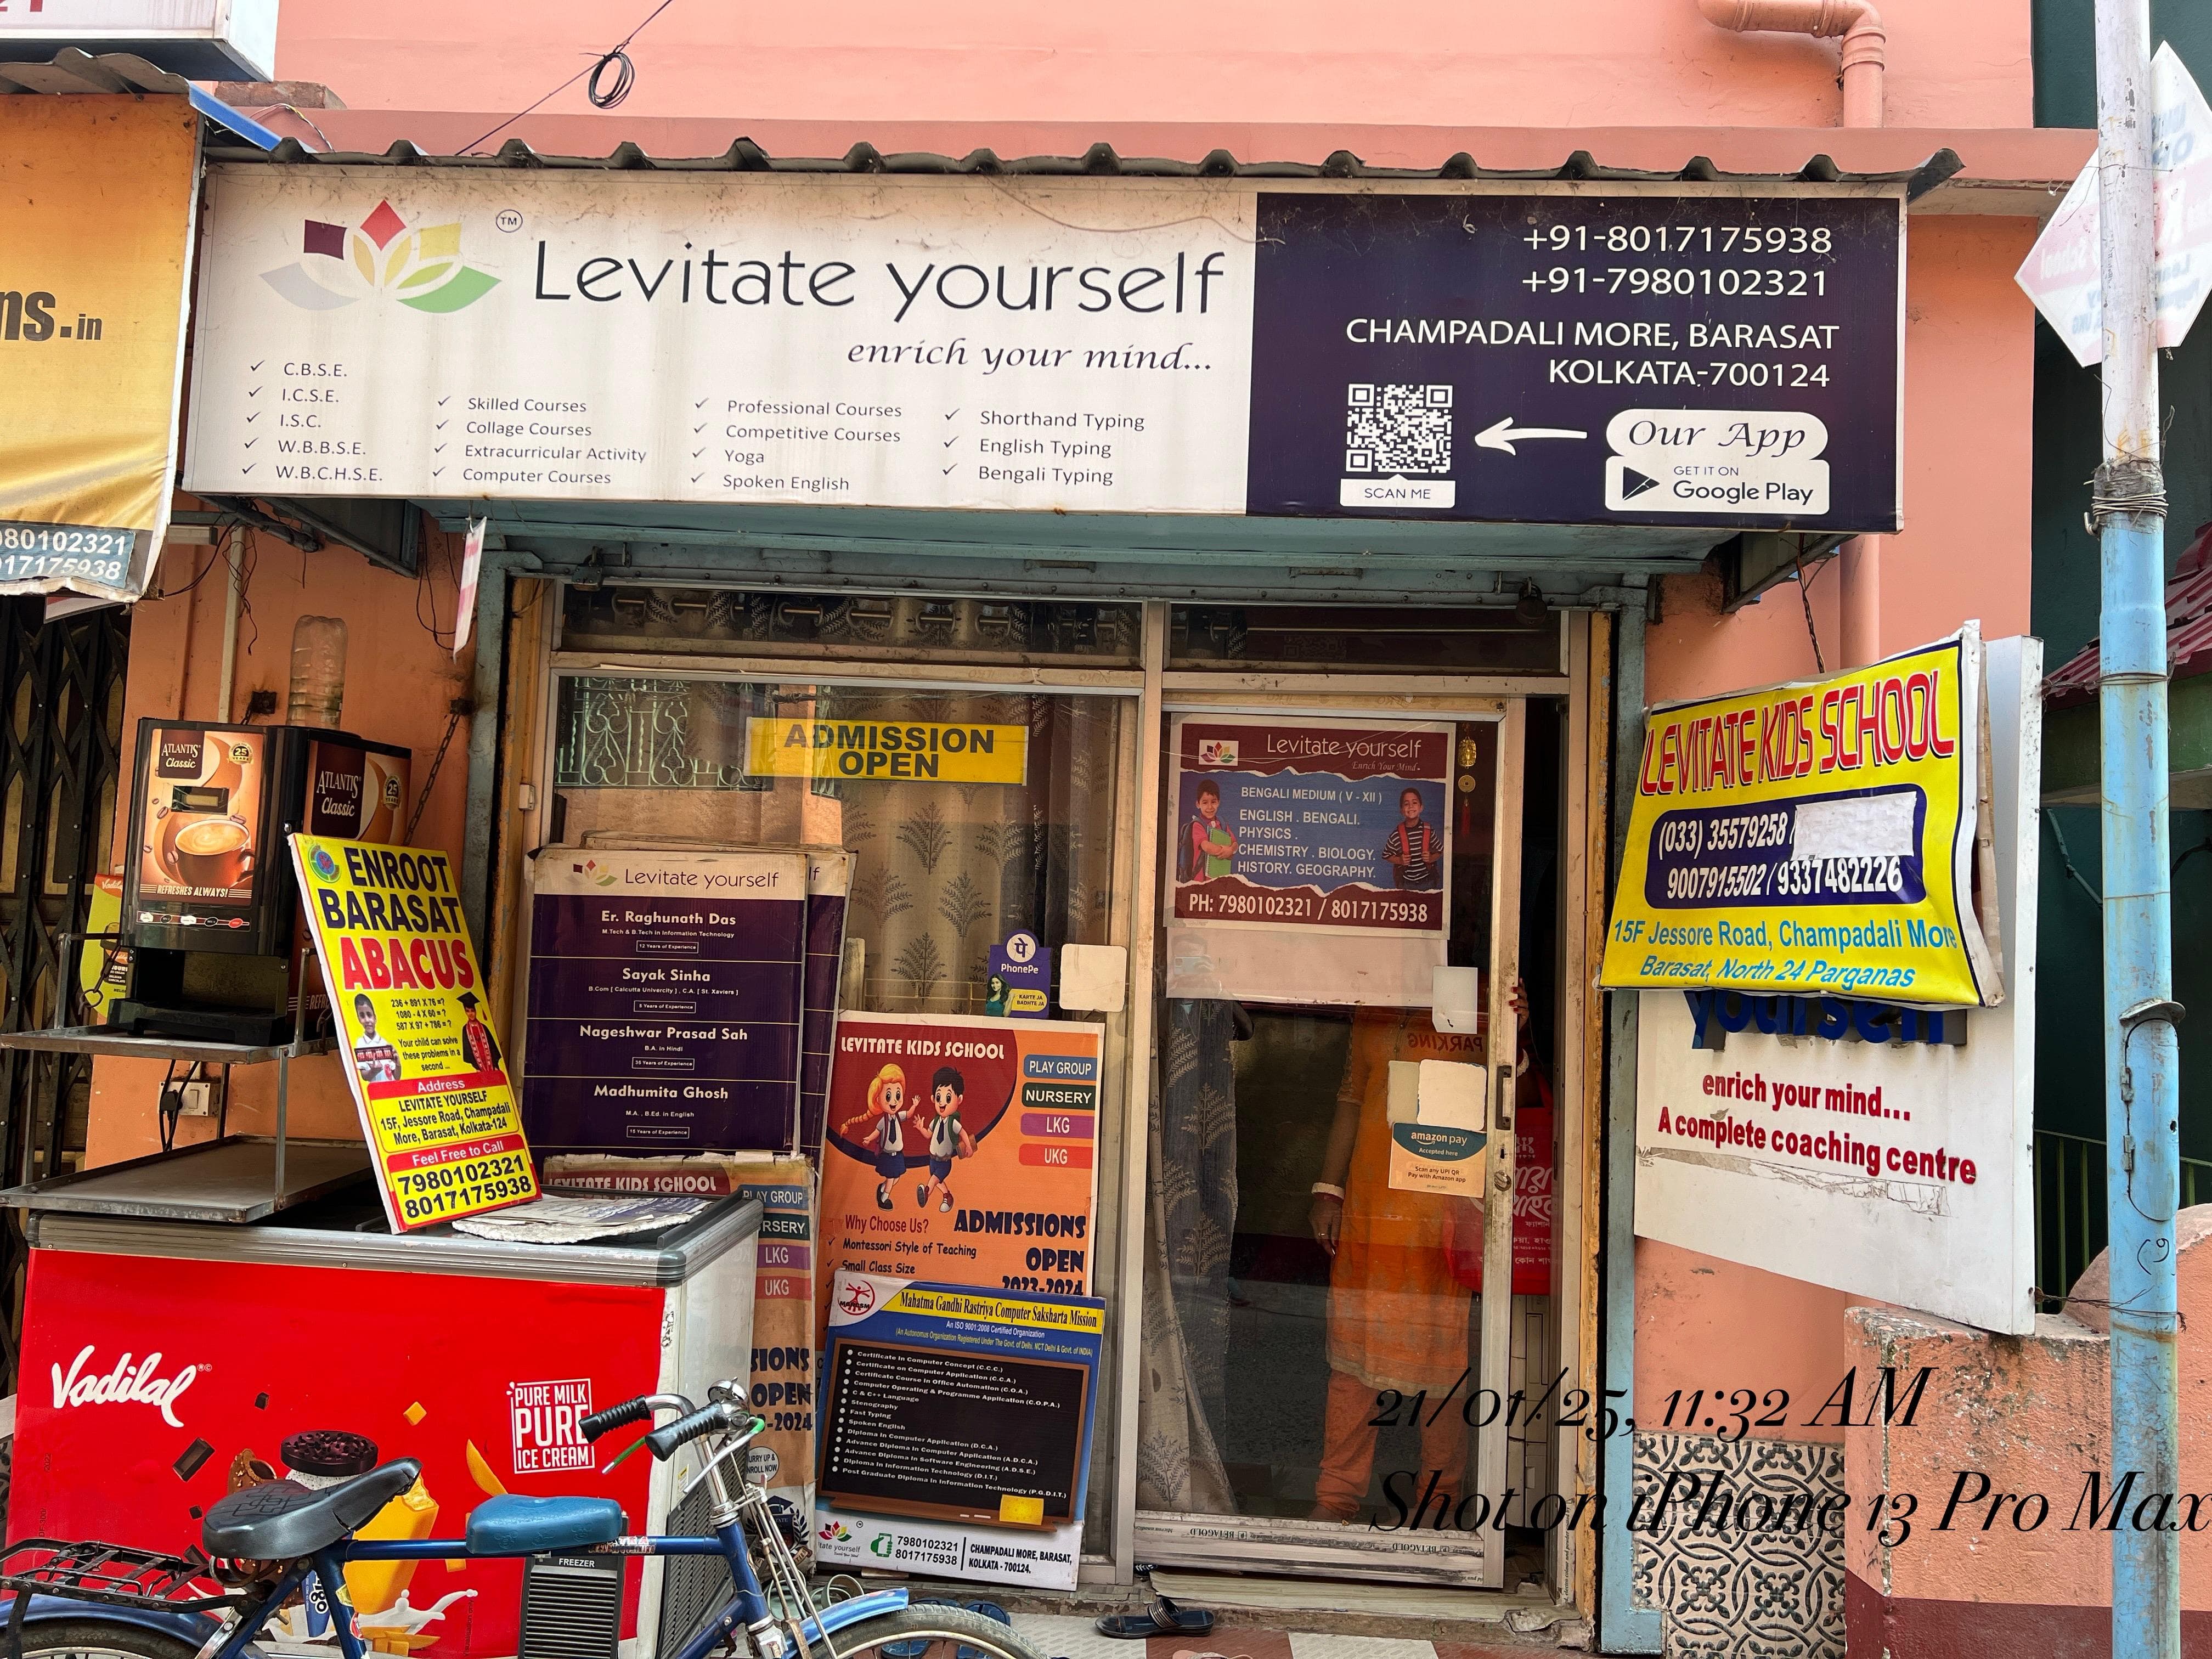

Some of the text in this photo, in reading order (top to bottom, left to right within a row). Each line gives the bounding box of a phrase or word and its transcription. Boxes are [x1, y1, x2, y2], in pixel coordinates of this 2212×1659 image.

[1524, 225, 1831, 253] +91-8017175938
[536, 241, 1224, 323] Levitate yourself
[1523, 267, 1824, 295] +91-7980102321
[1347, 319, 1839, 350] CHAMPADALI MORE, BARASAT
[848, 338, 1210, 374] enrich your mind...
[284, 363, 347, 376] C.B.S.E.
[283, 389, 338, 402] I.C.S.E.
[469, 398, 586, 411] Skilled Courses
[729, 400, 901, 416] Professional Courses
[281, 414, 320, 427] I.S.C.
[467, 422, 591, 437] Collage Courses
[981, 411, 1144, 431] Shorthand Typing
[727, 425, 900, 442] Competitive Courses
[1629, 421, 1805, 457] Our App
[279, 440, 365, 454] W.B.B.S.E.
[466, 445, 646, 463] Extracurricular Activity
[981, 439, 1111, 458] English Typing
[725, 450, 764, 465] Yoga
[276, 466, 382, 481] W.B.C.H.S.E.
[464, 469, 610, 483] Computer Courses
[980, 466, 1113, 486] Bengali Typing
[724, 475, 848, 492] Spoken English
[1674, 481, 1813, 505] Google Play
[1365, 488, 1431, 499] SCAN ME
[0, 529, 126, 557] 80102321
[784, 725, 994, 753] ADMISSION
[1640, 671, 1954, 796] LEVITATE KIDS SCHOOL
[161, 744, 198, 758] ATLANTIS
[1268, 735, 1421, 758] Levitate yourself
[166, 758, 196, 768] Classic
[839, 751, 938, 777] OPEN
[317, 771, 358, 798] ATLANTIS
[1242, 787, 1335, 800] BENGALI MEDIUM
[321, 797, 354, 816] Classic
[1240, 809, 1359, 825] ENGLISH BENGALI.
[1239, 827, 1291, 839] PHYSICS
[1659, 812, 1788, 860] (033) 35579258
[1239, 844, 1375, 860] CHEMISTRY BIOLOGY.
[343, 847, 448, 892] ENROOT
[626, 869, 778, 889] Levitate yourself
[1238, 861, 1375, 878] HISTORY. GEOGRAPHY.
[1668, 857, 1903, 899] 9007915502 9337482226
[157, 885, 228, 897] REFRESHES ALWAYS!
[318, 889, 461, 933] BARASAT
[1189, 894, 1427, 922] PH: 7980102321 8017175938
[602, 911, 736, 925] Er. Raghunath Das
[1615, 919, 1957, 953] 15F Jessore Road, Champadali More
[341, 937, 474, 990] ABACUS
[1001, 964, 1038, 974] PhonePe
[1640, 955, 1915, 990] Barasat, North 24 Parganas
[623, 968, 710, 982] Sayak Sinha
[580, 1025, 747, 1040] Nageshwar Prasad Sah
[842, 1037, 1004, 1059] LEVITATE KIDS SCHOOL
[1030, 1061, 1091, 1075] PLAY GROUP
[594, 1085, 727, 1098] Madhumita Ghosh
[1026, 1090, 1092, 1103] NURSERY
[1703, 1071, 1910, 1121] enrich your mind...
[1047, 1117, 1069, 1133] LKG
[1411, 1132, 1467, 1146] amazon pay
[1658, 1107, 1976, 1184] A complete coaching centre
[1045, 1148, 1067, 1164] UKG
[397, 1155, 523, 1195] 7980102321
[405, 1176, 531, 1218] 8017175938
[771, 1191, 803, 1204] GROUP
[954, 1210, 1086, 1238] ADMISSIONS
[1026, 1248, 1084, 1273] OPEN
[902, 1292, 1096, 1327] Mahatma Gandhi Rastriya Computer Saksharta Mission
[52, 1345, 196, 1427] Vadilal
[515, 1384, 586, 1407] PURE MILK
[514, 1408, 587, 1446] PURE
[518, 1446, 588, 1469] ICE CREAM
[559, 1558, 594, 1567] FREEZER
